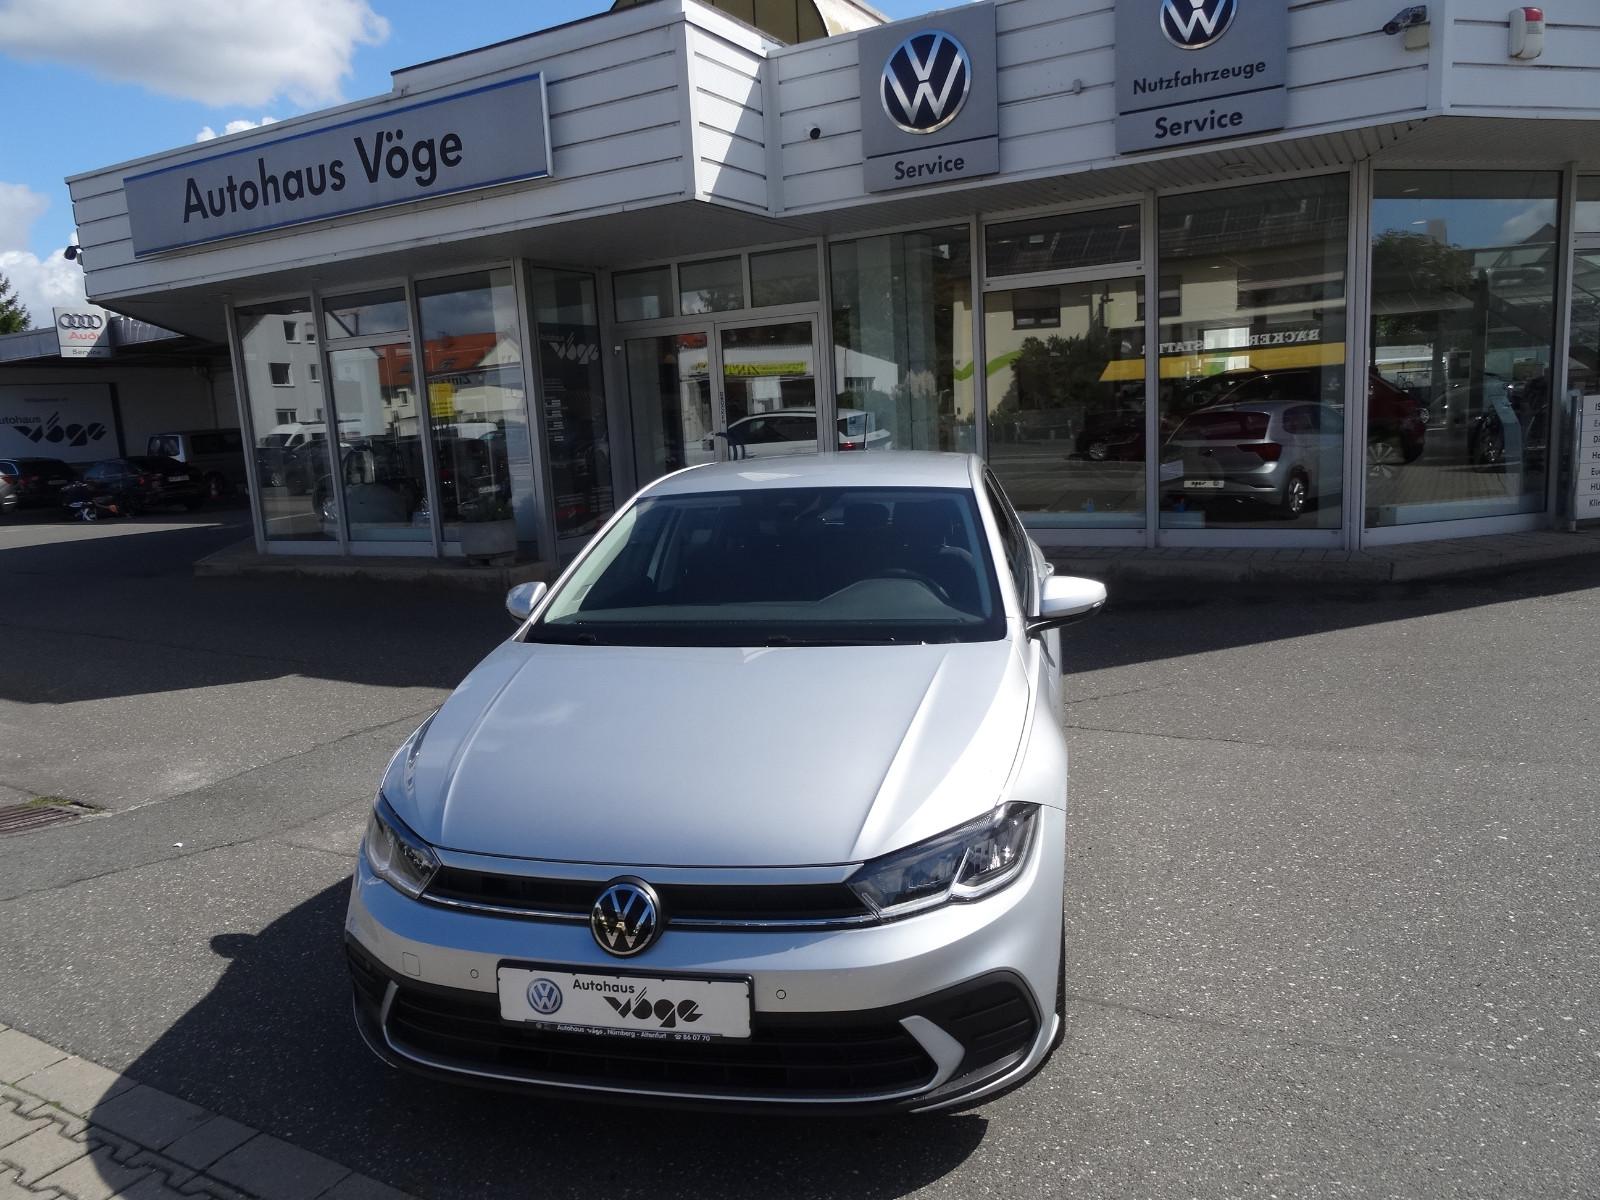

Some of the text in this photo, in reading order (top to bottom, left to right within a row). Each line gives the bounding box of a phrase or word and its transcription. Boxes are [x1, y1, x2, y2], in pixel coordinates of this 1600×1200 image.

[1133, 61, 1266, 95] Nutzfahrzeuge
[1154, 109, 1243, 139] Service
[183, 129, 463, 223] Autohaus Vöge
[894, 155, 965, 181] Service
[68, 331, 101, 341] Audi
[572, 978, 635, 994] Autohaus
[556, 1024, 585, 1033] Autohaus
[607, 1029, 636, 1039] Nürnberg
